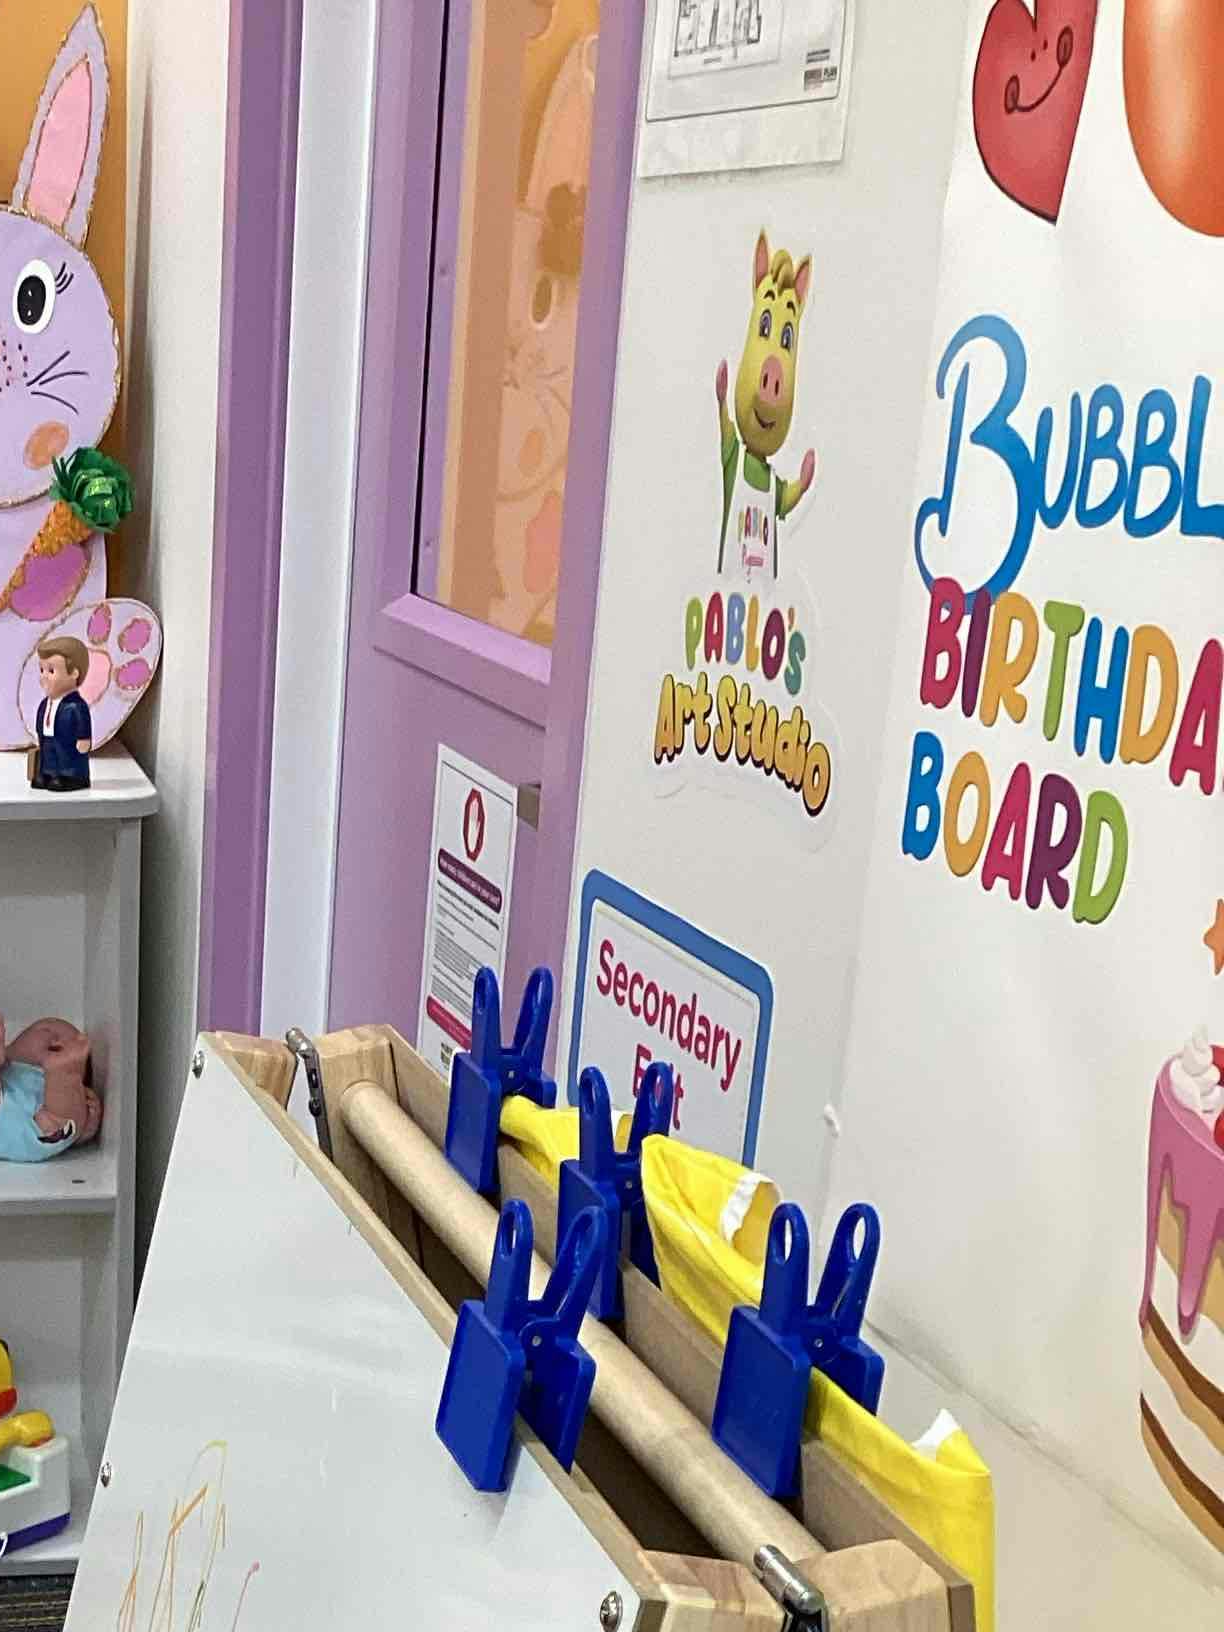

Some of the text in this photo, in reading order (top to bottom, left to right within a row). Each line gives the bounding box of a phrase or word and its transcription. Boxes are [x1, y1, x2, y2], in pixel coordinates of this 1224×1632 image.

[653, 671, 832, 817] Art Studio
[919, 577, 1224, 797] BIRTHDA
[901, 730, 1129, 926] BOARD
[596, 938, 742, 1093] Secondary
